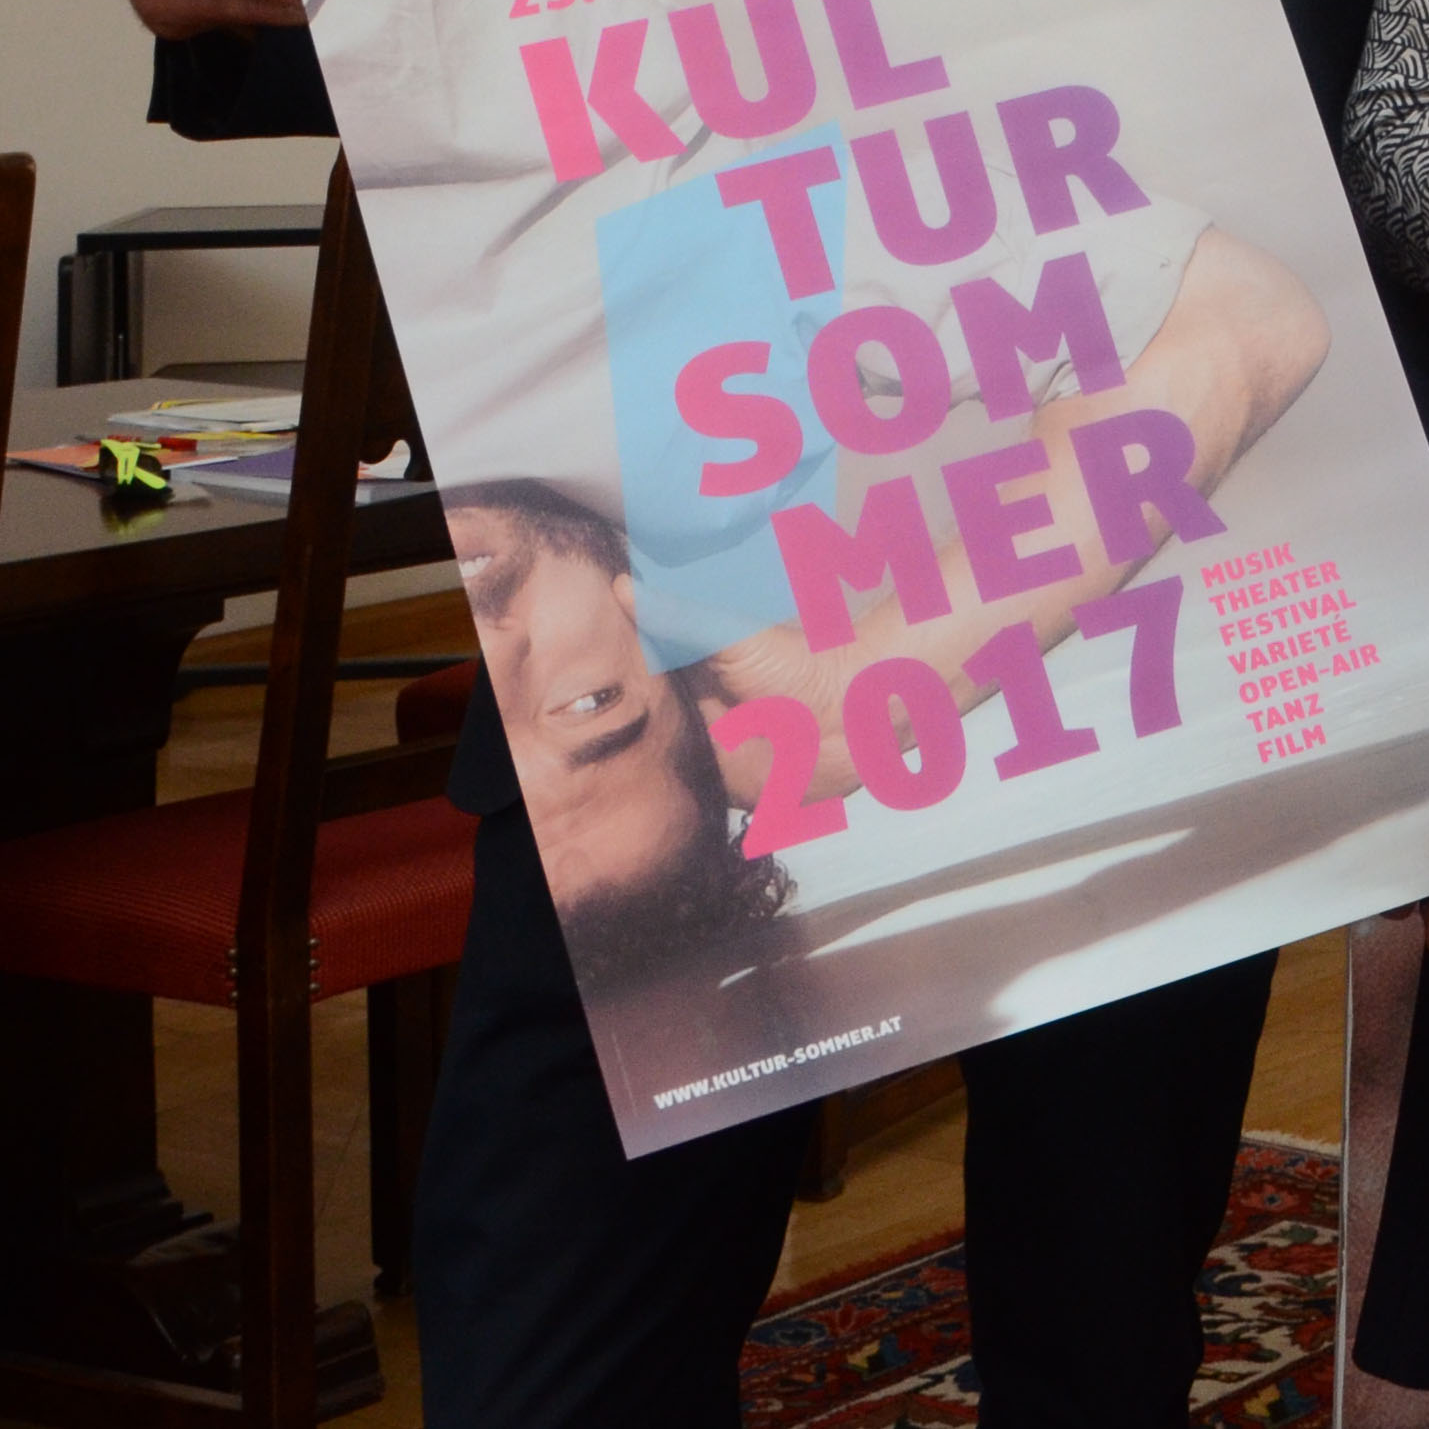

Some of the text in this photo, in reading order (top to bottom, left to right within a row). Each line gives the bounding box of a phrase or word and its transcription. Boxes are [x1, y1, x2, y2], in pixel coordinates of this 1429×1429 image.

[715, 83, 1151, 303] TUR
[673, 251, 1128, 498] SOM
[769, 406, 1229, 654] MER
[1201, 542, 1296, 589] MUSIK
[1208, 561, 1341, 617] THEATER
[1219, 588, 1357, 647] FESTIVAL
[1227, 614, 1352, 675] VARIETÉ
[1239, 643, 1381, 704] OPEN-AIR
[711, 574, 1187, 861] 2017
[1246, 692, 1325, 734] TANZ
[1256, 724, 1327, 764] FILM
[653, 1016, 902, 1110] WWW.KULTUR-SOMMER.AT
